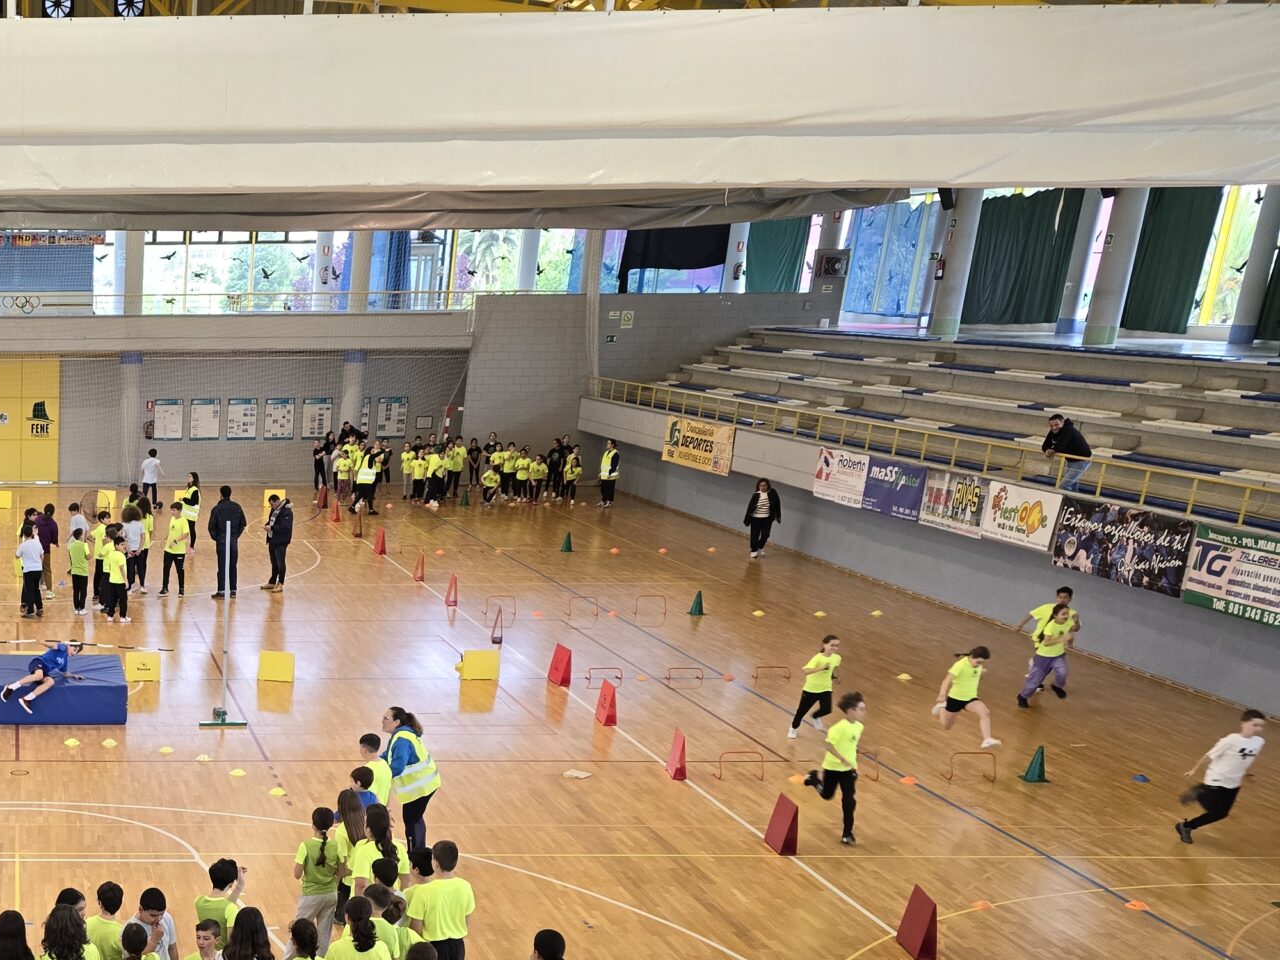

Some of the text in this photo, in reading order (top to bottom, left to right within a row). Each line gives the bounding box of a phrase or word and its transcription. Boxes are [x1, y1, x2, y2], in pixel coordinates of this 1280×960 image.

[31, 423, 49, 434] FENE
[681, 434, 714, 453] DEPORTES
[837, 454, 866, 472] Roberto
[951, 479, 981, 513] RIVAS
[1156, 529, 1171, 547] de
[1192, 541, 1233, 577] TG
[1240, 550, 1278, 568] TALLERES
[1228, 602, 1243, 616] 981
[1245, 606, 1261, 621] 343
[1263, 611, 1280, 626] 562
